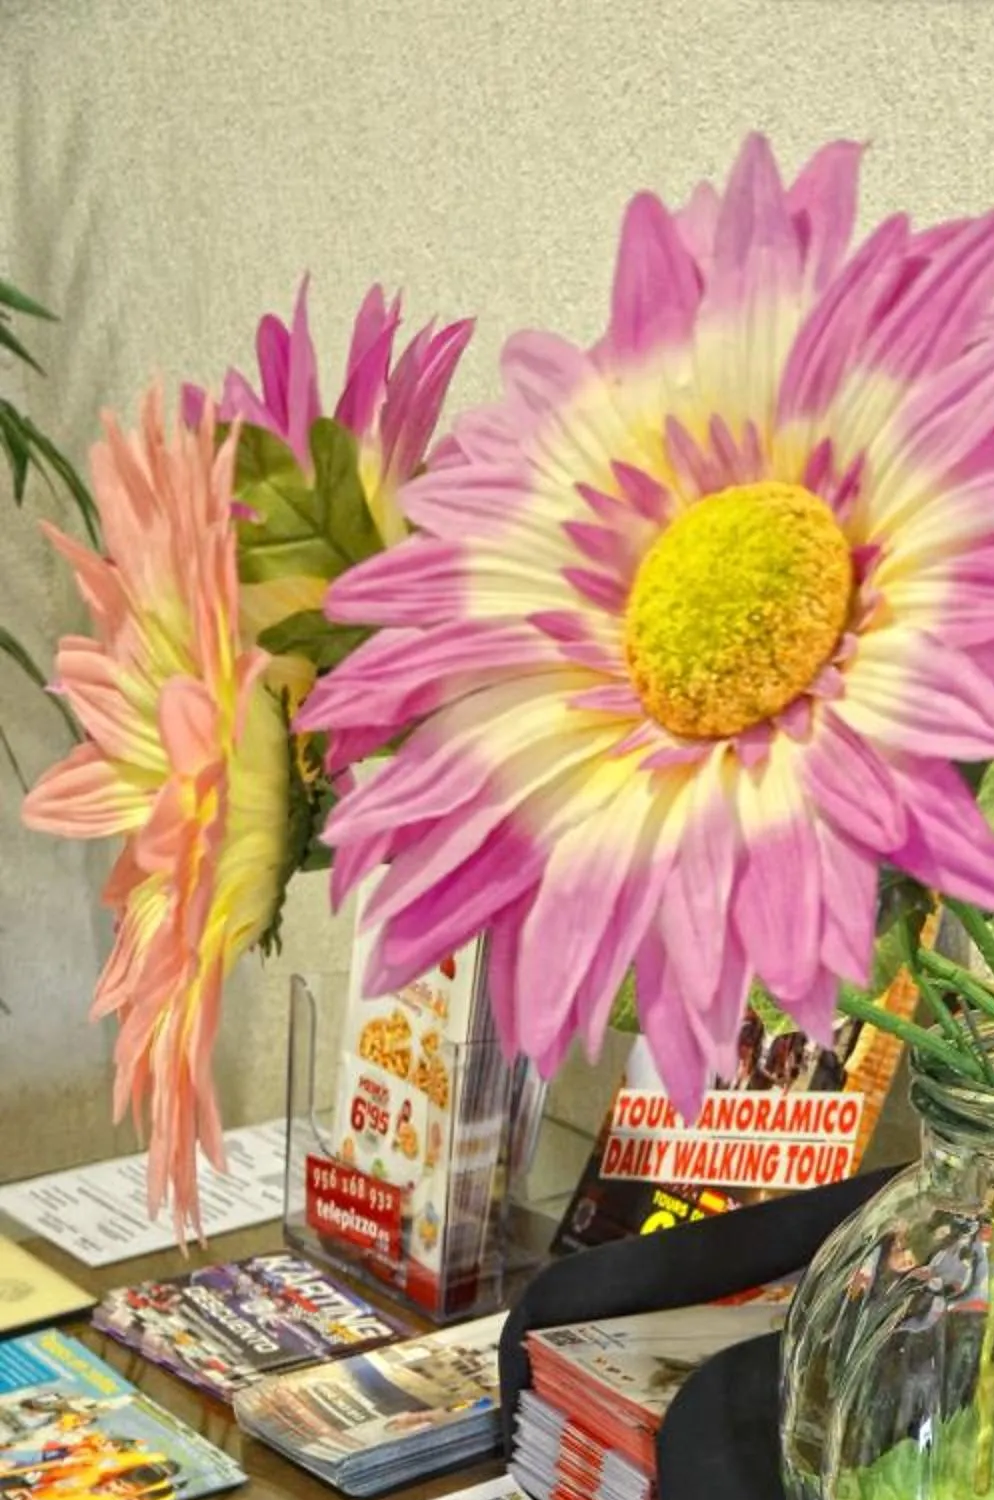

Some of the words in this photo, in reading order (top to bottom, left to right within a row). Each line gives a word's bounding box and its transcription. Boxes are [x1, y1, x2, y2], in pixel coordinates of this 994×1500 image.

[617, 1095, 677, 1129] TOUR
[697, 1091, 858, 1134] ANORÁMICO
[603, 1138, 671, 1176] DAILY
[672, 1141, 782, 1182] WALKING
[784, 1145, 850, 1185] TOUR
[182, 1284, 280, 1354] DESCUENTO
